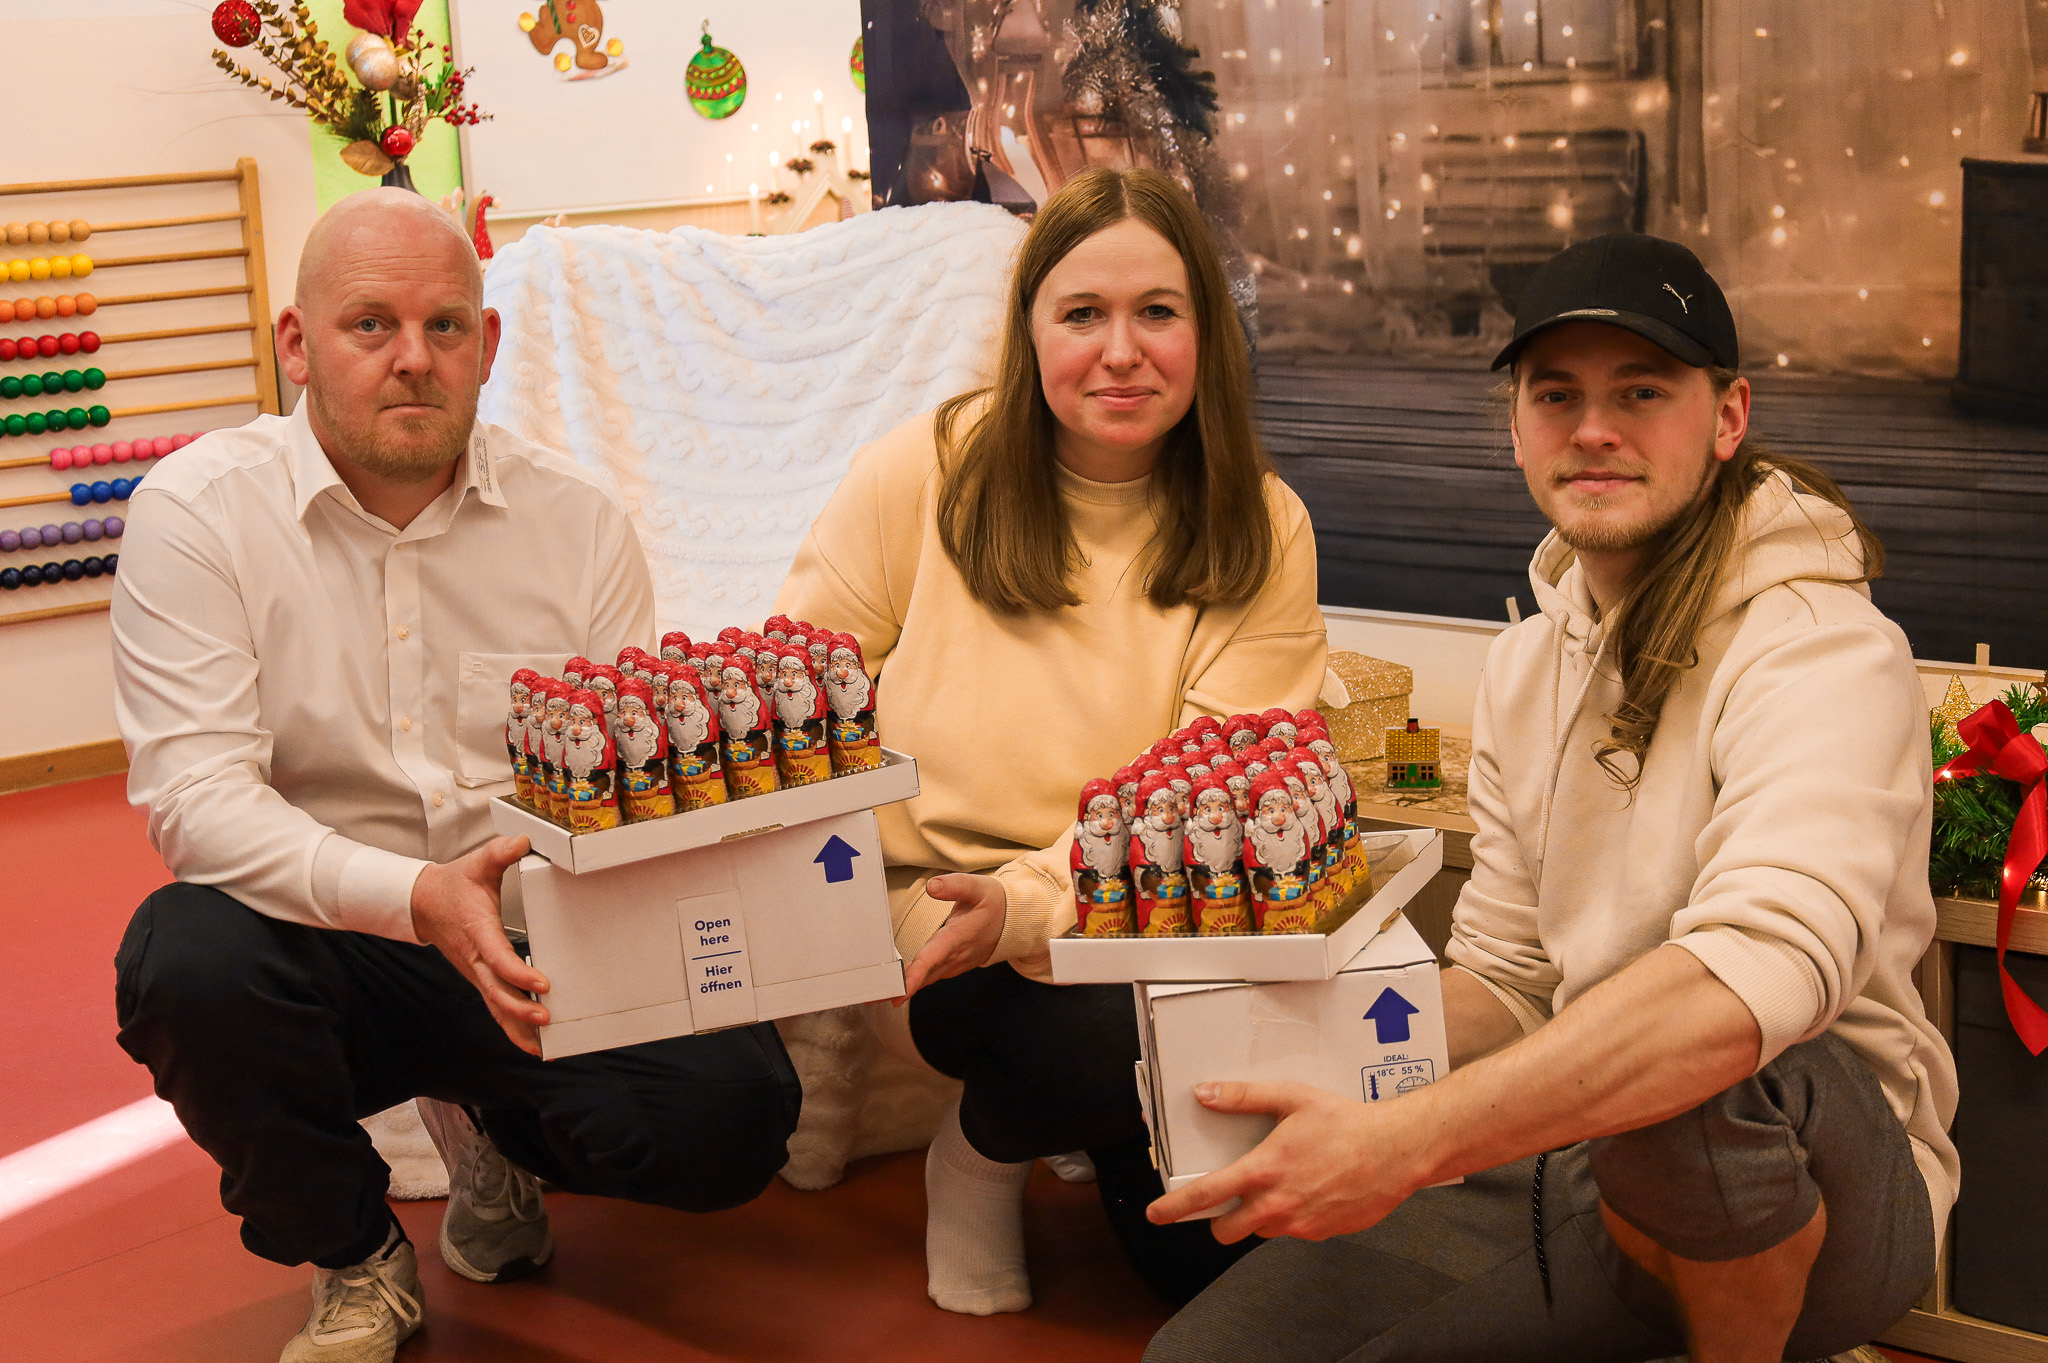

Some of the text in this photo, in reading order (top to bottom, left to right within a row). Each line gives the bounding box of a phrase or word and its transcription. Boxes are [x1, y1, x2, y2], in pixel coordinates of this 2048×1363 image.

[694, 918, 731, 932] Open
[700, 934, 730, 946] here
[705, 964, 733, 977] Hier
[700, 980, 742, 994] öffnen
[1383, 1054, 1409, 1063] IDEAL:
[1377, 1065, 1424, 1077] 18°C 55 %
